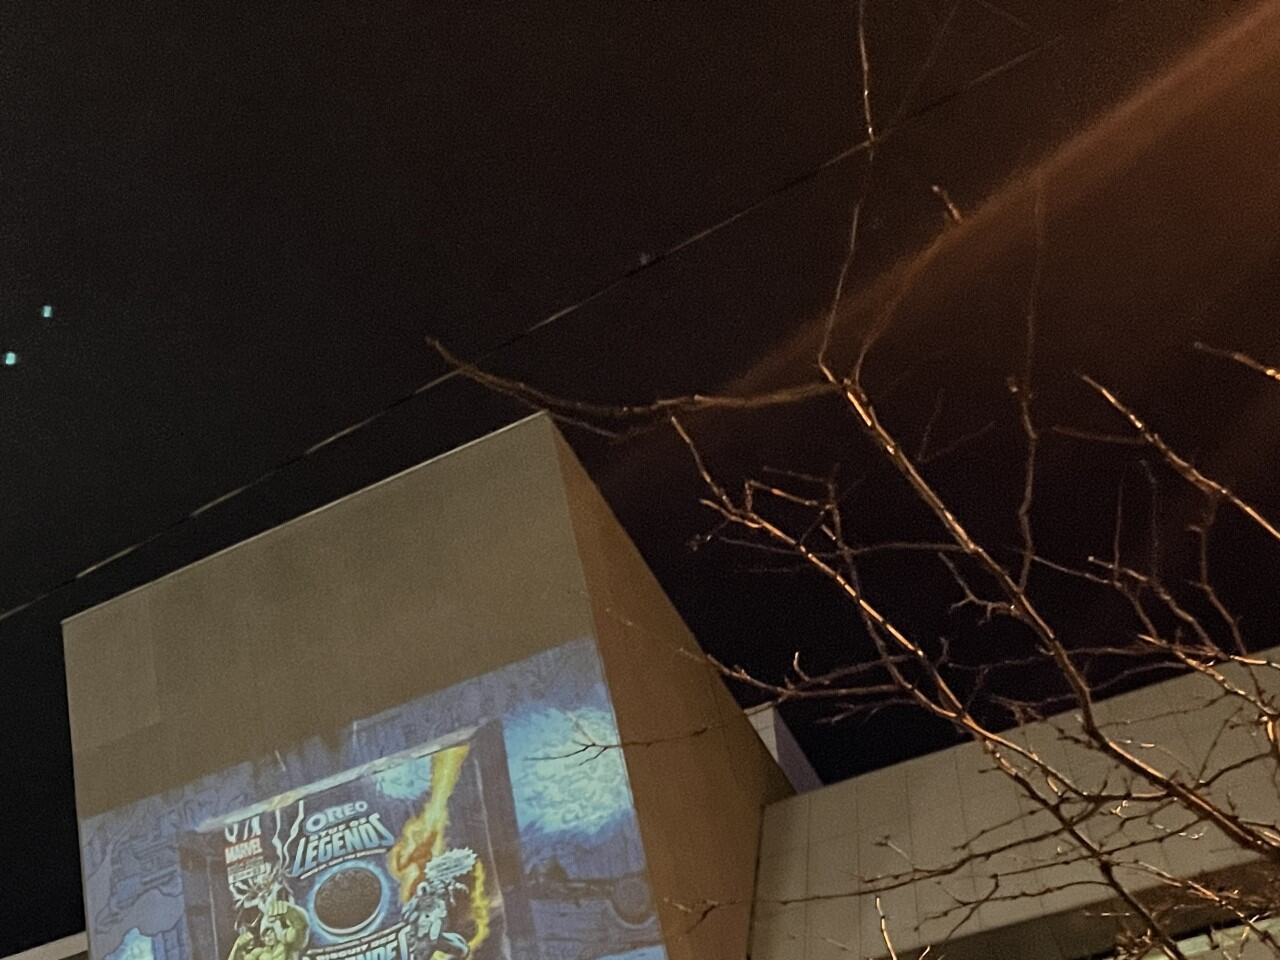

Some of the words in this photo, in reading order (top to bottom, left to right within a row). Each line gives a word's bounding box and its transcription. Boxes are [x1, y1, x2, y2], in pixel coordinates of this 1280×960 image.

[305, 800, 368, 833] OREO
[225, 838, 263, 865] MARVEL
[292, 812, 395, 877] LEGENDS
